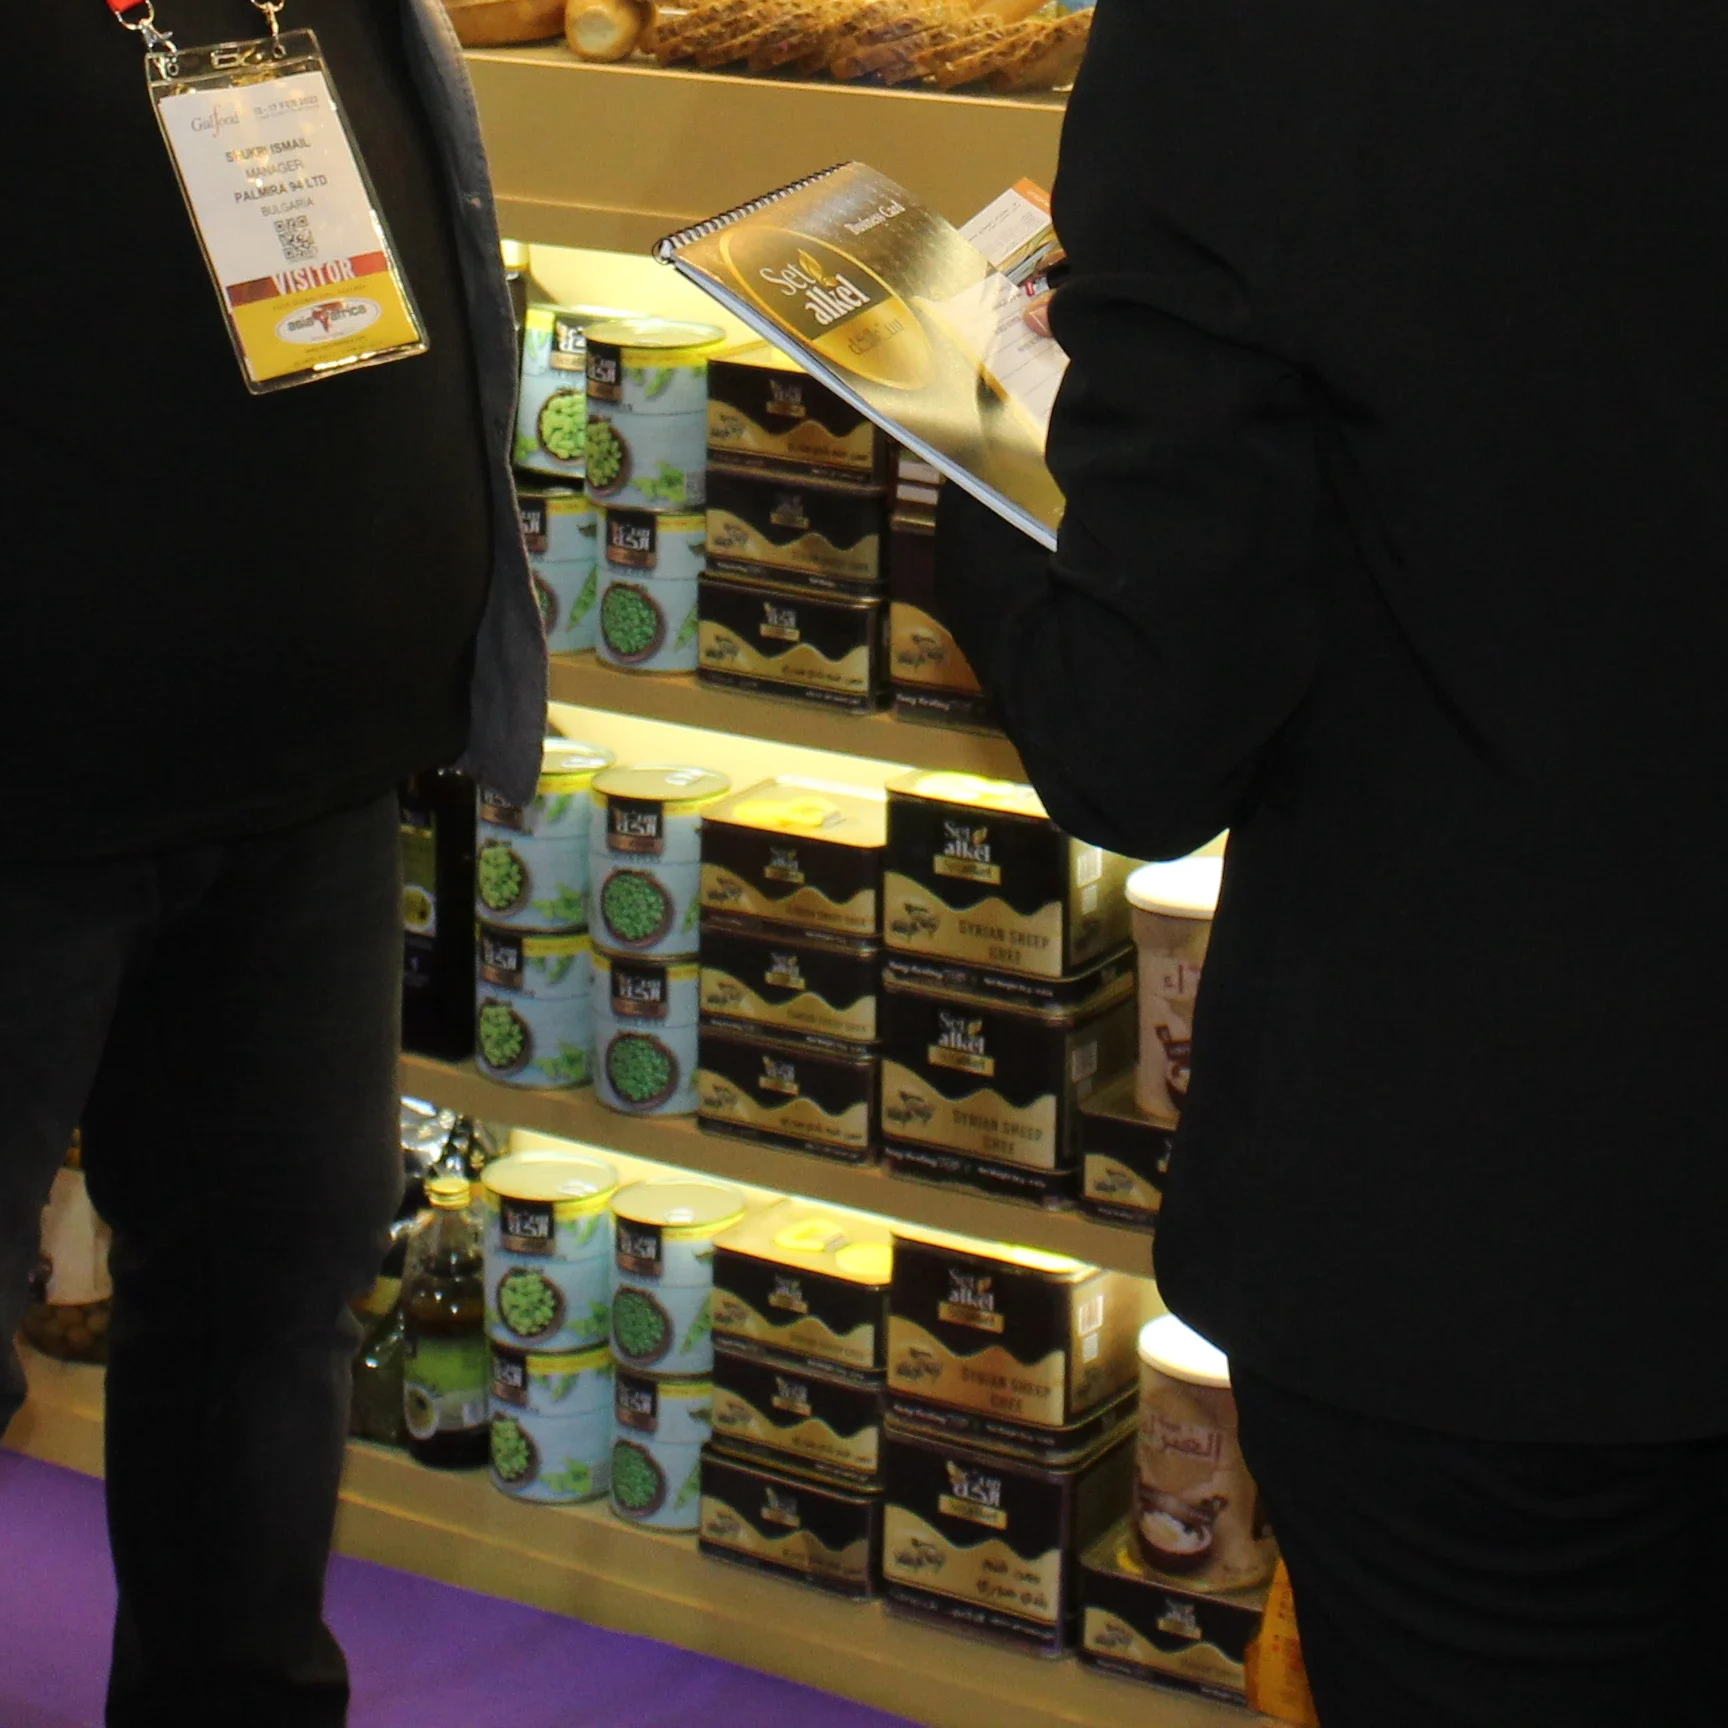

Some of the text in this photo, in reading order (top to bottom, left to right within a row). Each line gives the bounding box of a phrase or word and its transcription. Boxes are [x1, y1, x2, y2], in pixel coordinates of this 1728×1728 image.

[269, 138, 311, 153] ISMAIL
[245, 159, 303, 179] MANAGER
[234, 184, 287, 204] PALMIRA
[303, 174, 328, 190] LTD
[261, 197, 315, 218] BULGARIA
[272, 258, 355, 296] VISITOR
[759, 262, 817, 297] Set
[804, 273, 872, 326] alkel
[942, 838, 992, 864] alkel
